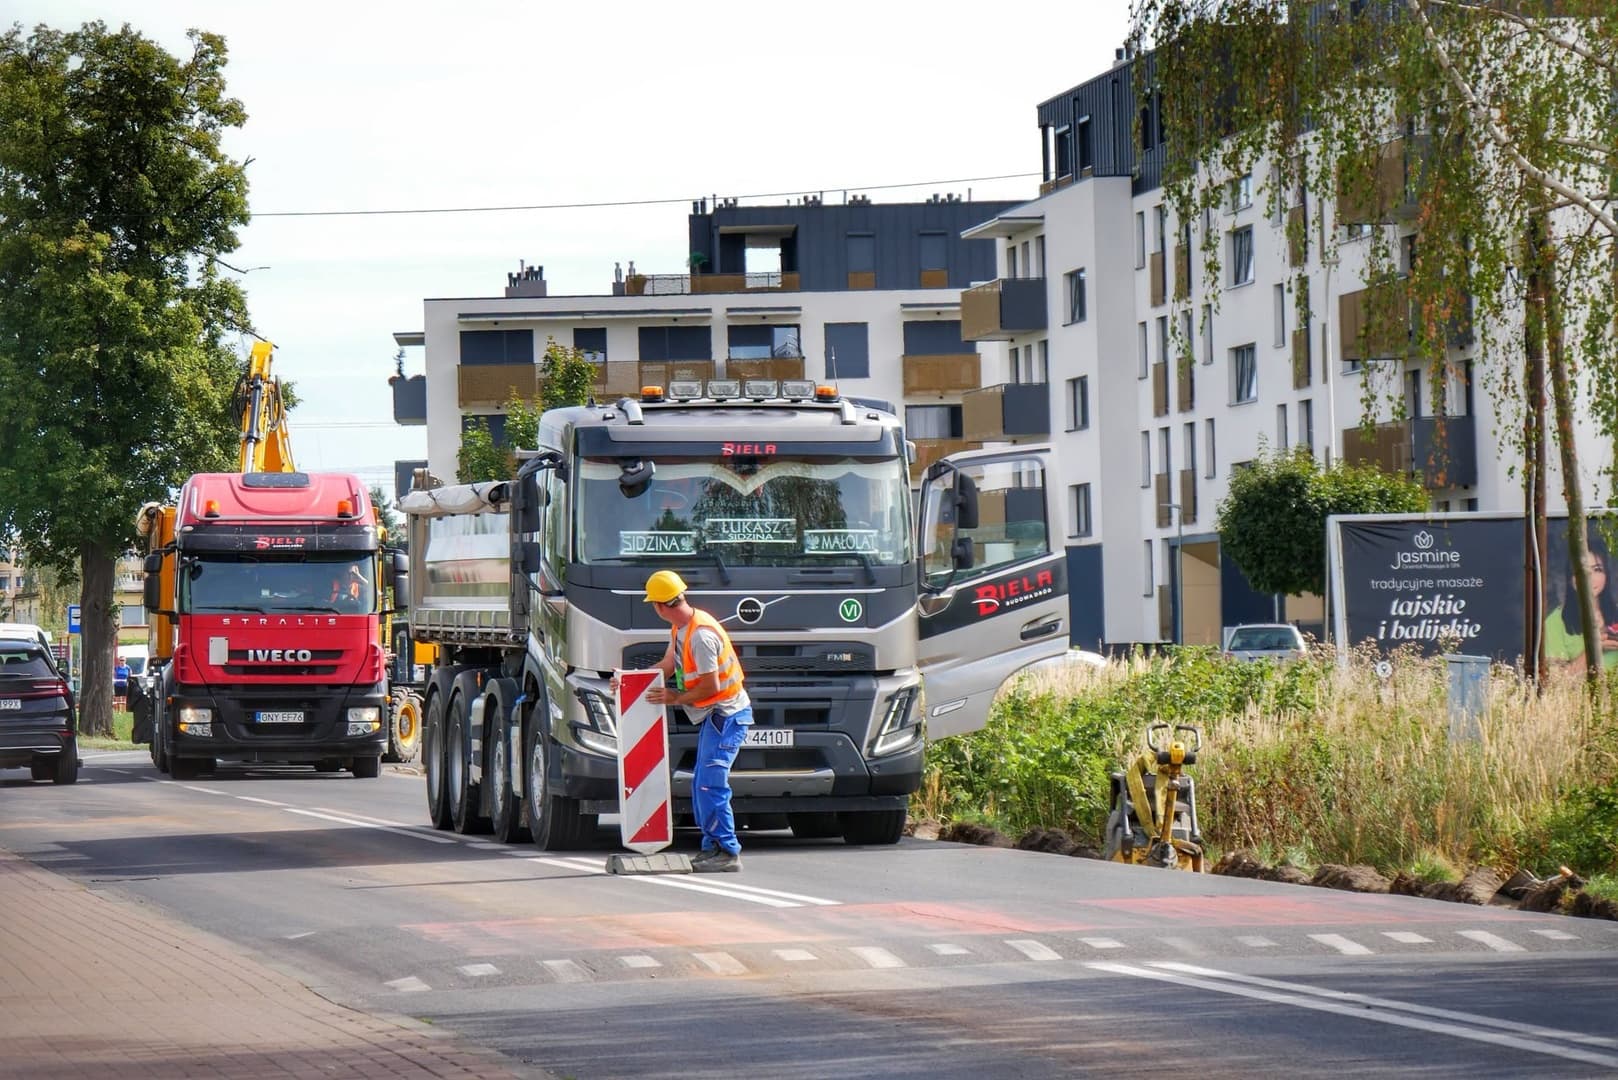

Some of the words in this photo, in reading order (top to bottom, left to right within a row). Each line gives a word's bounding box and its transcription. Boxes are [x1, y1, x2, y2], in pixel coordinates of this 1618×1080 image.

[722, 442, 777, 456] BIELA
[721, 521, 781, 533] ŁUKASZ
[255, 536, 305, 549] BIELA
[623, 535, 680, 551] SIDZINA
[1371, 578, 1434, 591] tradycyjne
[1436, 577, 1484, 588] masaże
[975, 569, 1053, 617] BIELA
[843, 604, 858, 617] VI
[1390, 594, 1466, 618] tajskie
[1378, 620, 1387, 640] i
[1390, 618, 1481, 641] balijskie
[247, 649, 312, 662] IVECO
